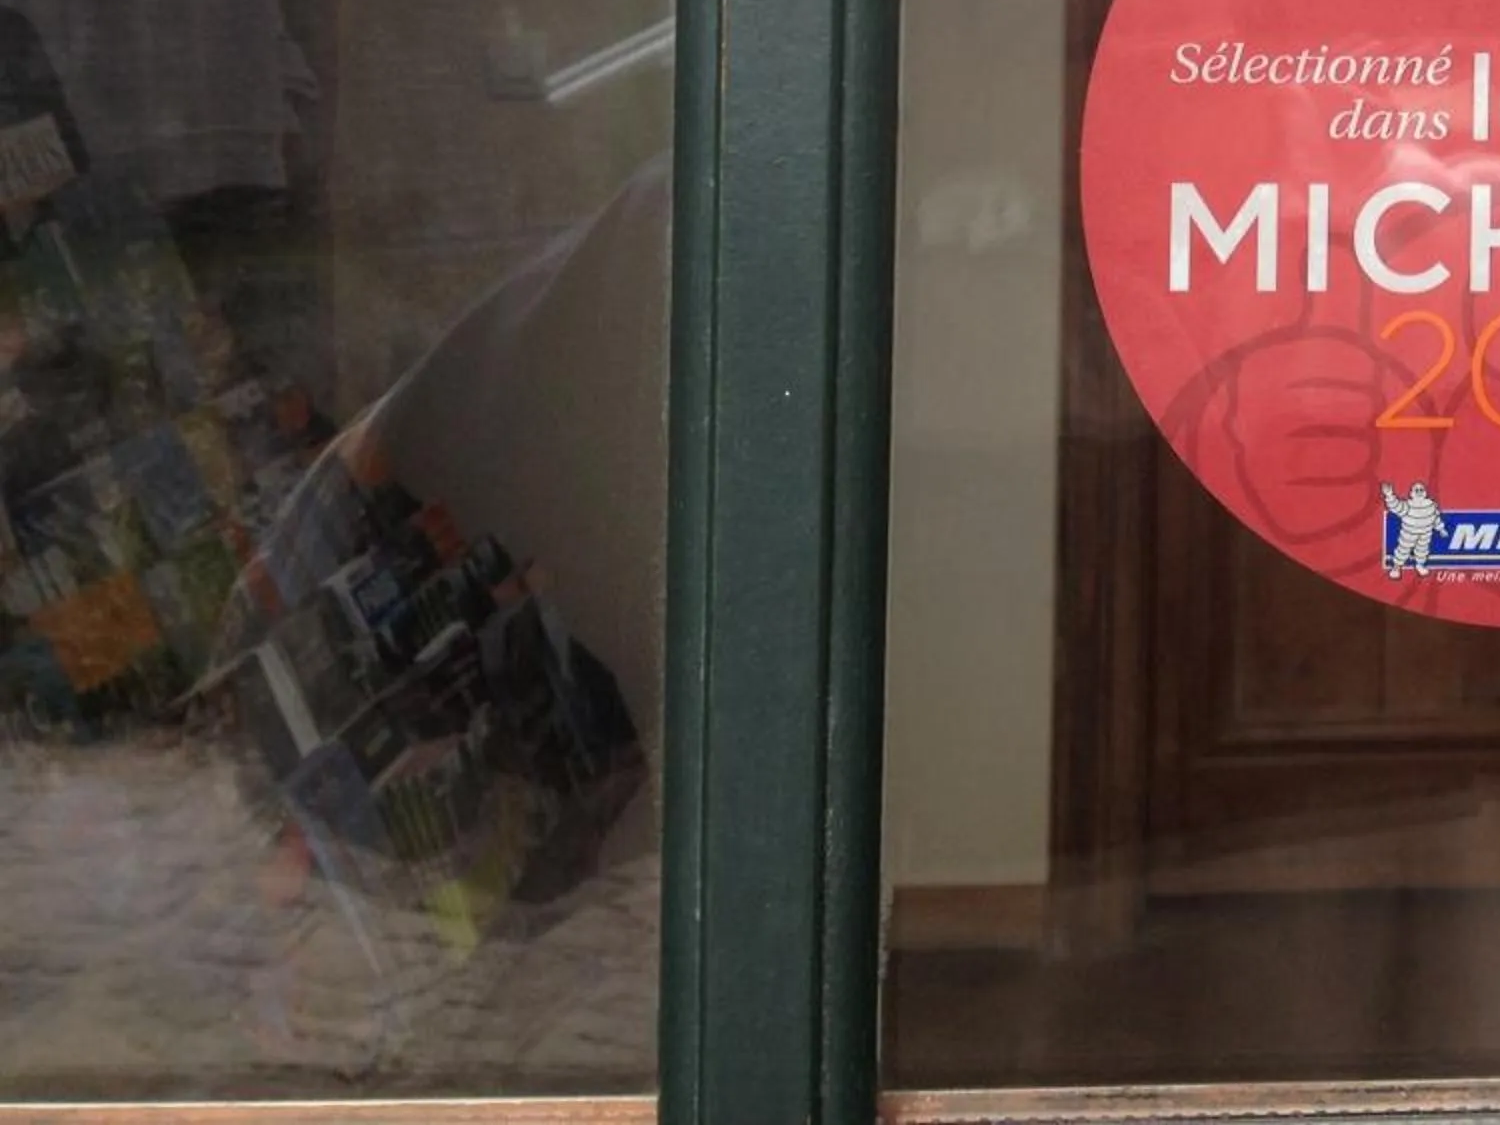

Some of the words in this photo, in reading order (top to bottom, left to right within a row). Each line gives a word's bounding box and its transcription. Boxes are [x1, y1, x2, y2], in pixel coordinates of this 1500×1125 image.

[1170, 41, 1452, 87] Sélectionné
[1328, 97, 1451, 142] dans
[1435, 569, 1466, 583] Une
